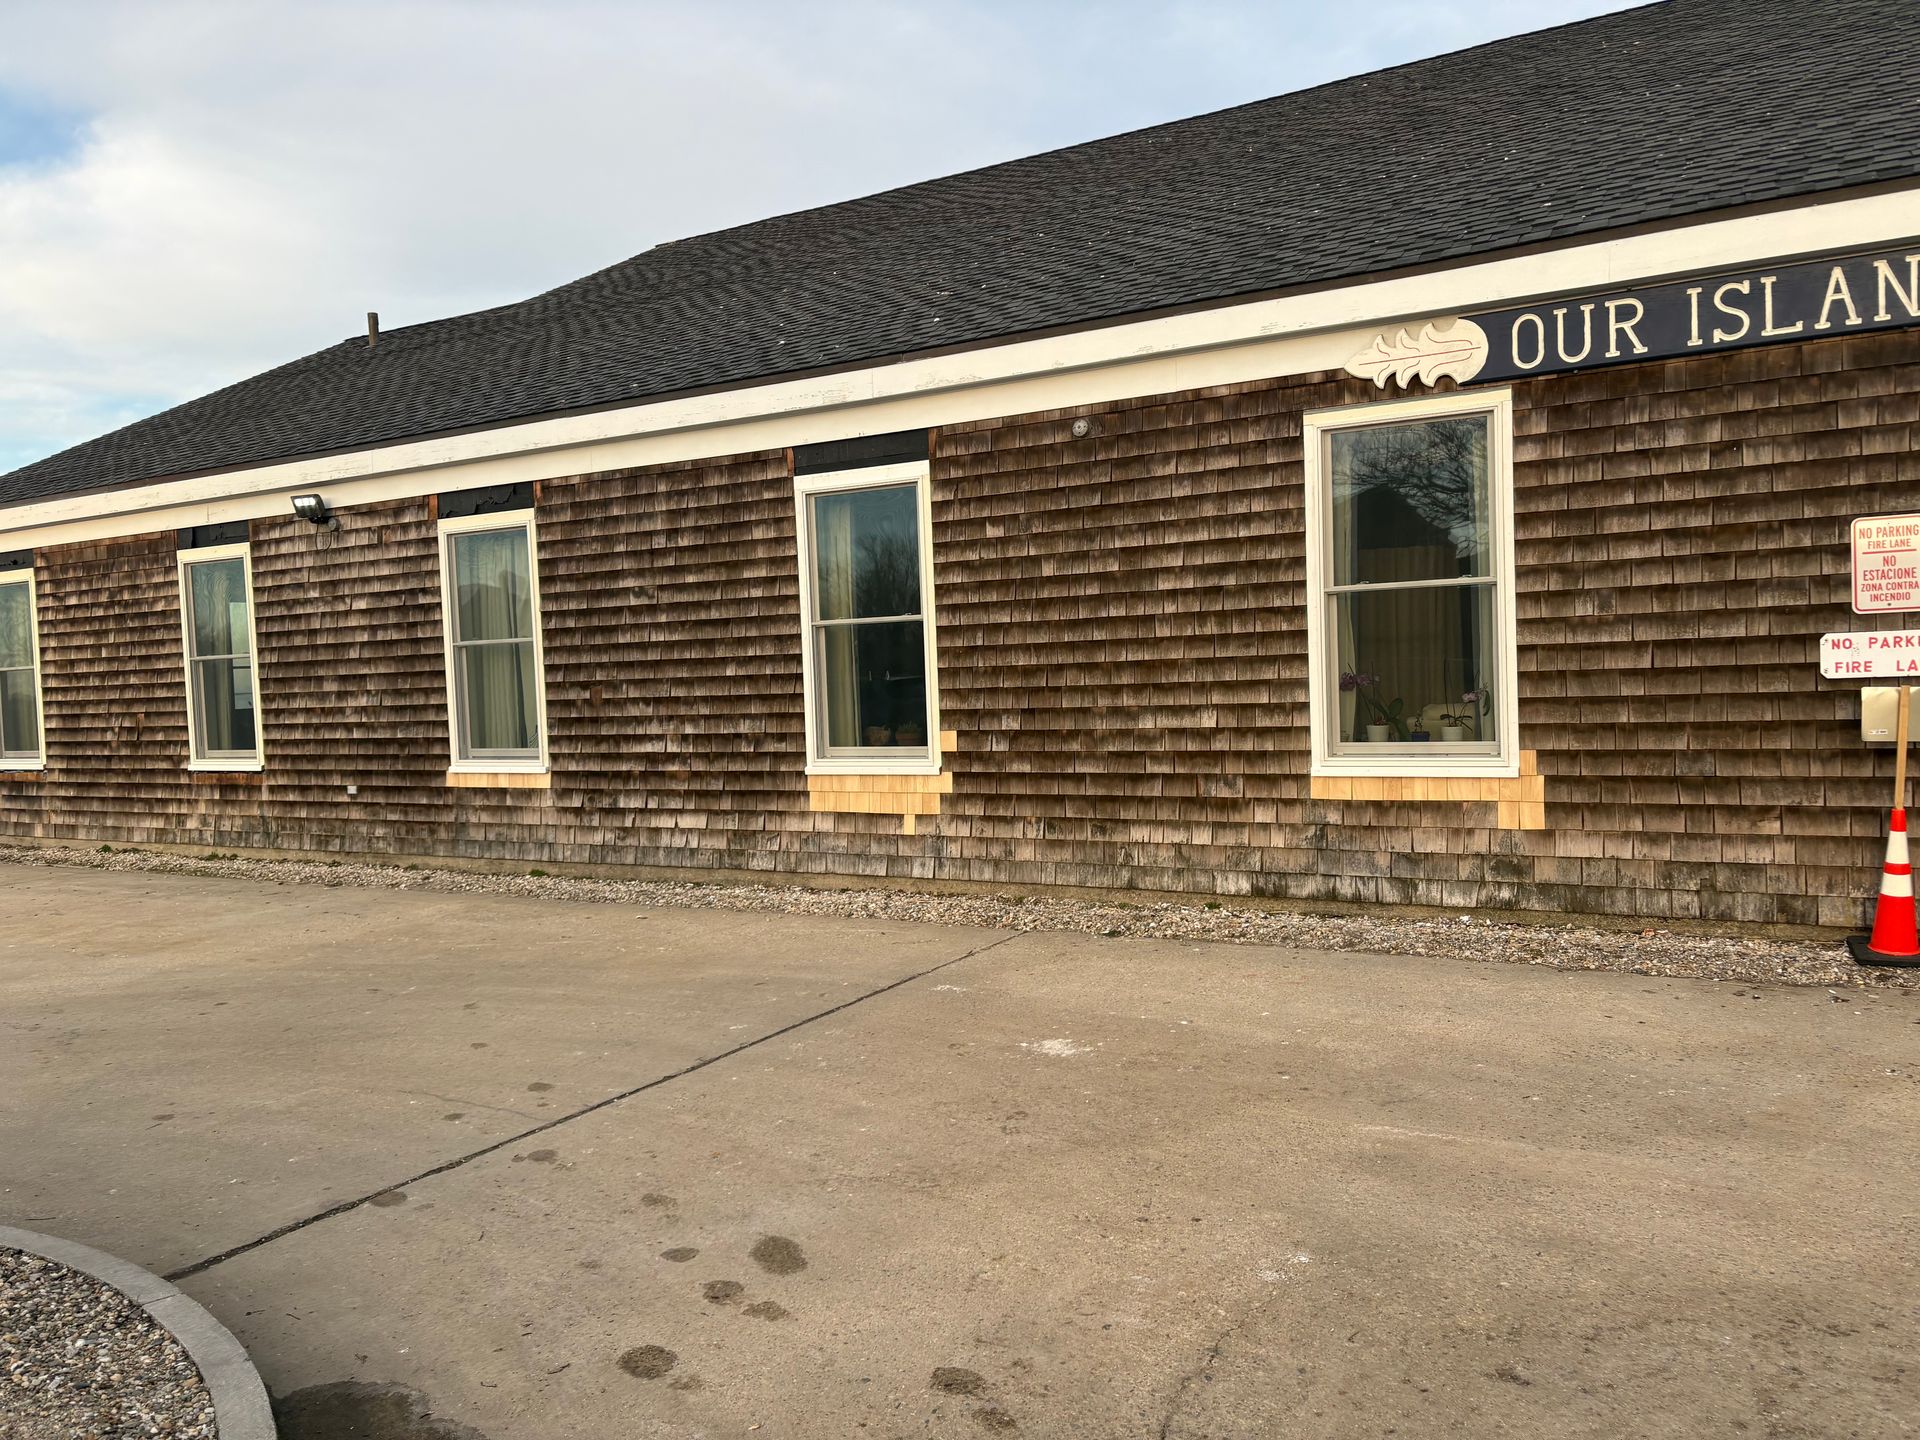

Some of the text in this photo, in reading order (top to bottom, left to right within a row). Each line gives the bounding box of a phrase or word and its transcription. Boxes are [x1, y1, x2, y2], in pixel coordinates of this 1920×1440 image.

[1511, 254, 1920, 369] OUR ISLAN
[1859, 524, 1919, 539] NO PARKING
[1868, 539, 1911, 549] FIRE LANE
[1883, 555, 1897, 567] NO
[1863, 567, 1917, 581] ESTACIONE
[1861, 581, 1919, 592] ZONA CONTRA
[1870, 592, 1911, 602] INCENDIO
[1831, 638, 1853, 650] NO
[1835, 659, 1918, 673] FIRE LA
